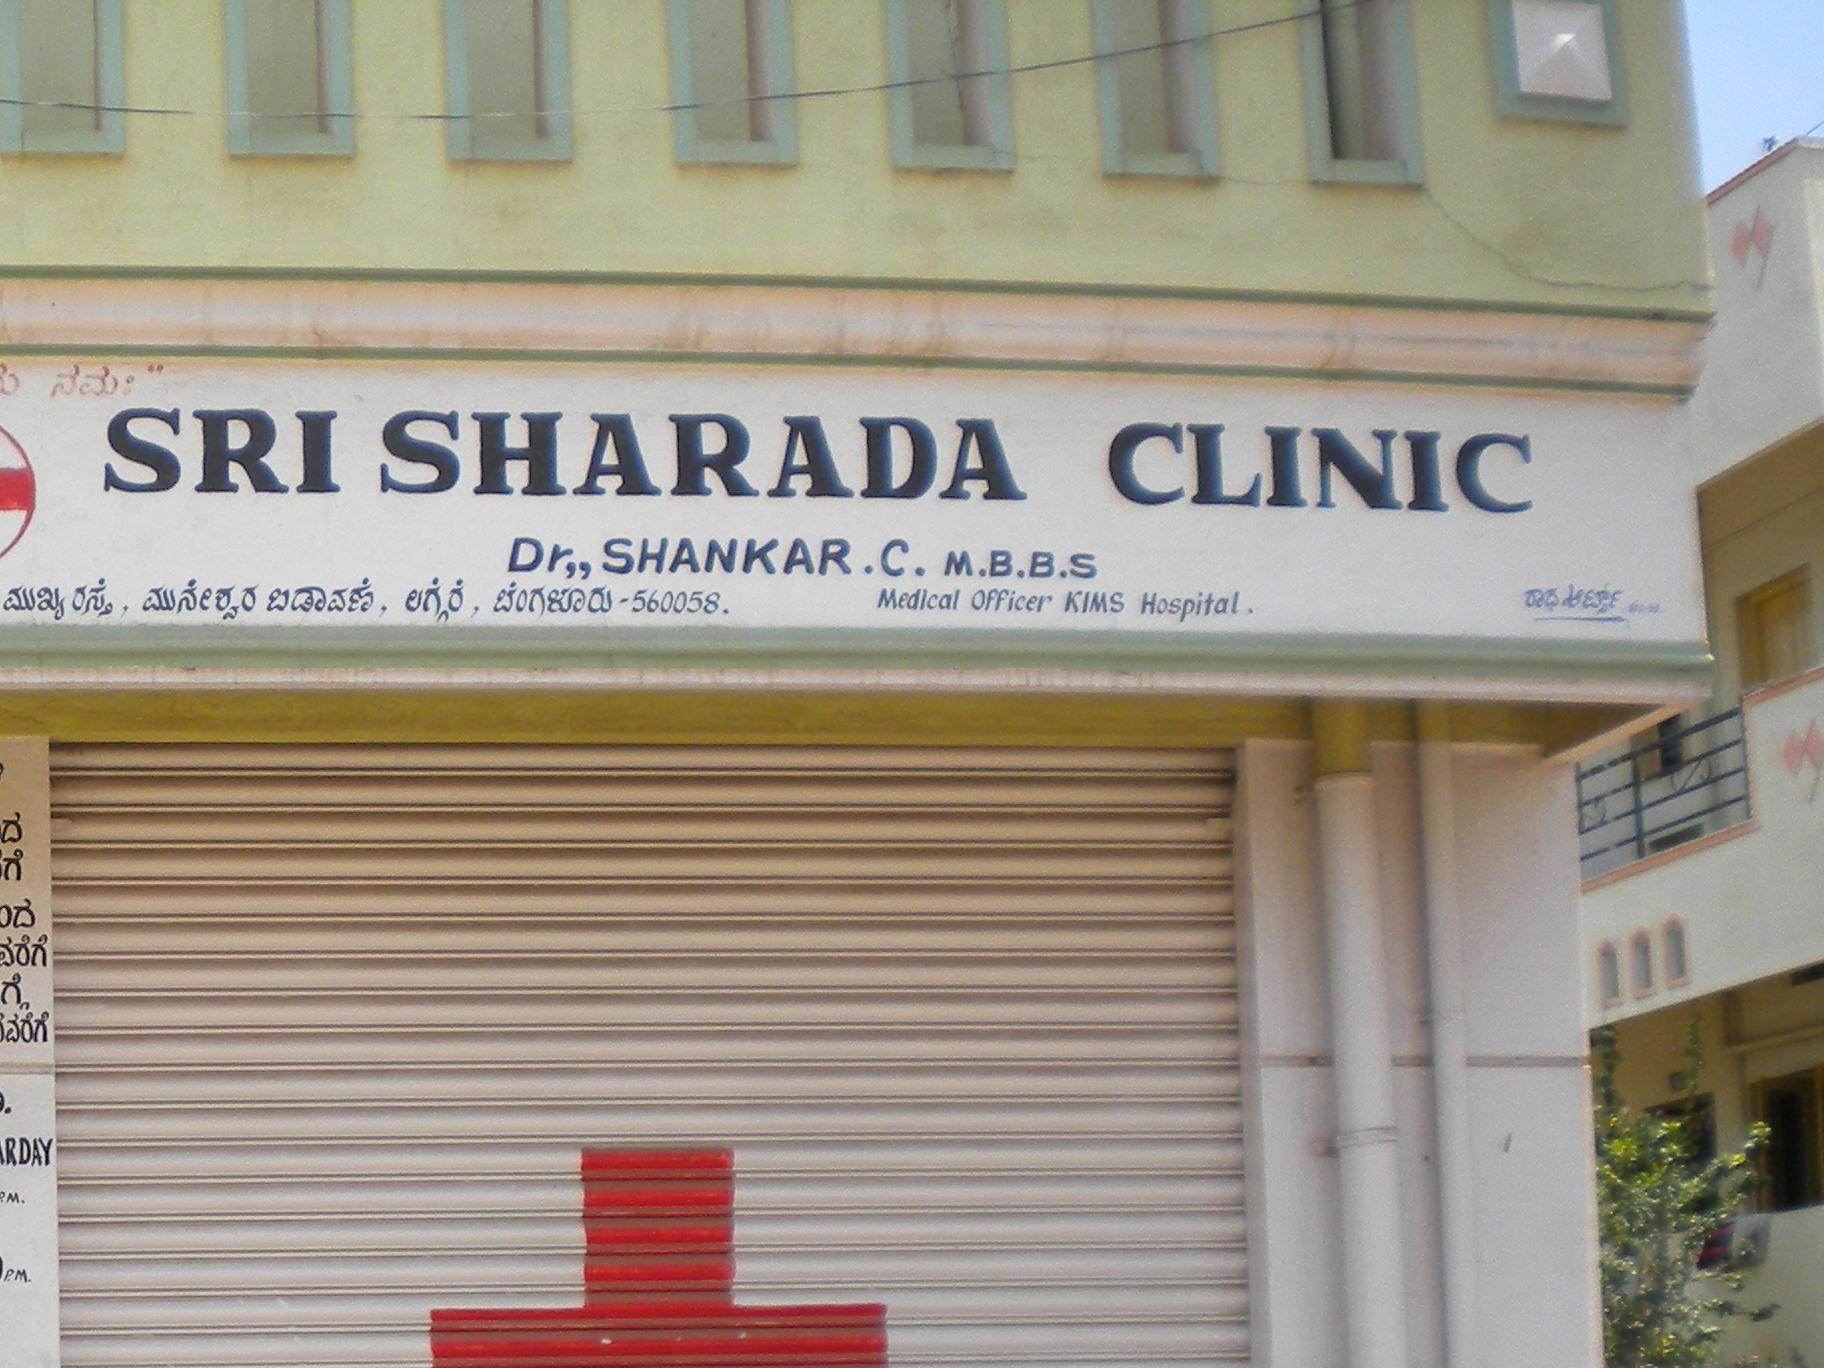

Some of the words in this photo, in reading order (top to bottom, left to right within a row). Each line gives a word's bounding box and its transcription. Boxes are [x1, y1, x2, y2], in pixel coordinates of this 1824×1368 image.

[102, 407, 341, 495] SRI
[379, 409, 1027, 500] SHARADA
[1107, 421, 1534, 514] CLINIC
[877, 587, 961, 610] Medical
[971, 587, 1053, 613] Officer
[1064, 589, 1126, 614] KIMS
